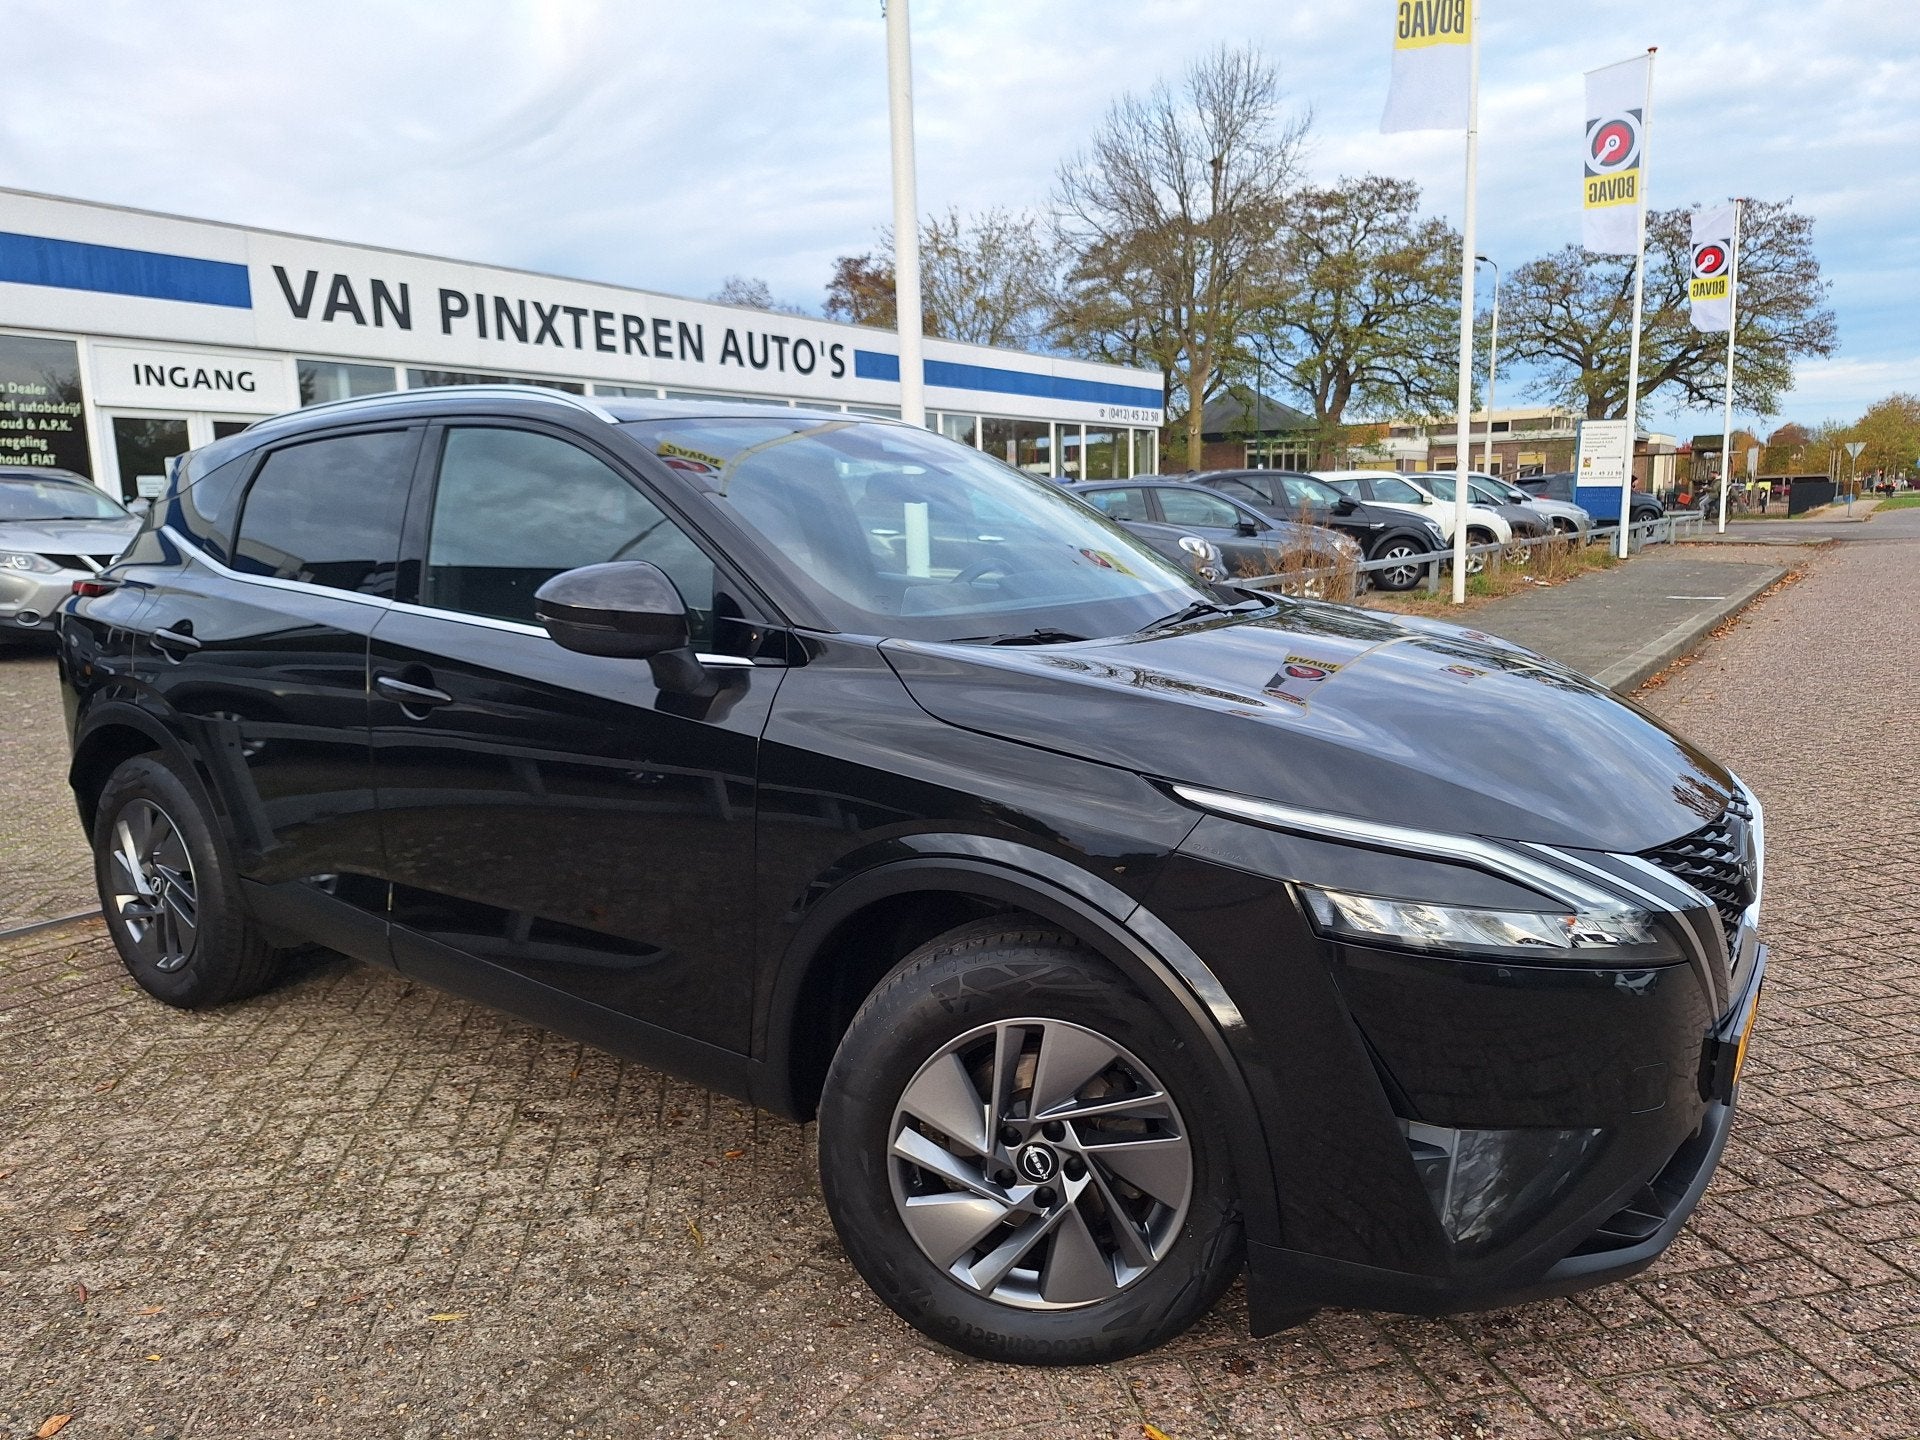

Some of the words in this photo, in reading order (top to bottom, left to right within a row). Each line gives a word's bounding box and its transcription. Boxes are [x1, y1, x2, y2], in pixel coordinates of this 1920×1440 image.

[272, 265, 412, 331] VAN
[438, 287, 705, 363] PINXTEREN
[719, 328, 845, 379] AUTO'S
[133, 363, 255, 392] INGANG
[8, 382, 46, 395] Dealer
[19, 401, 81, 417] autobedrijf
[1109, 407, 1130, 421] (0412)
[1131, 409, 1139, 420] 45
[1141, 410, 1149, 421] 22
[1150, 411, 1159, 422] 50
[26, 418, 36, 430] &
[31, 453, 56, 466] FIAT
[1026, 1145, 1049, 1180] NISSAN
